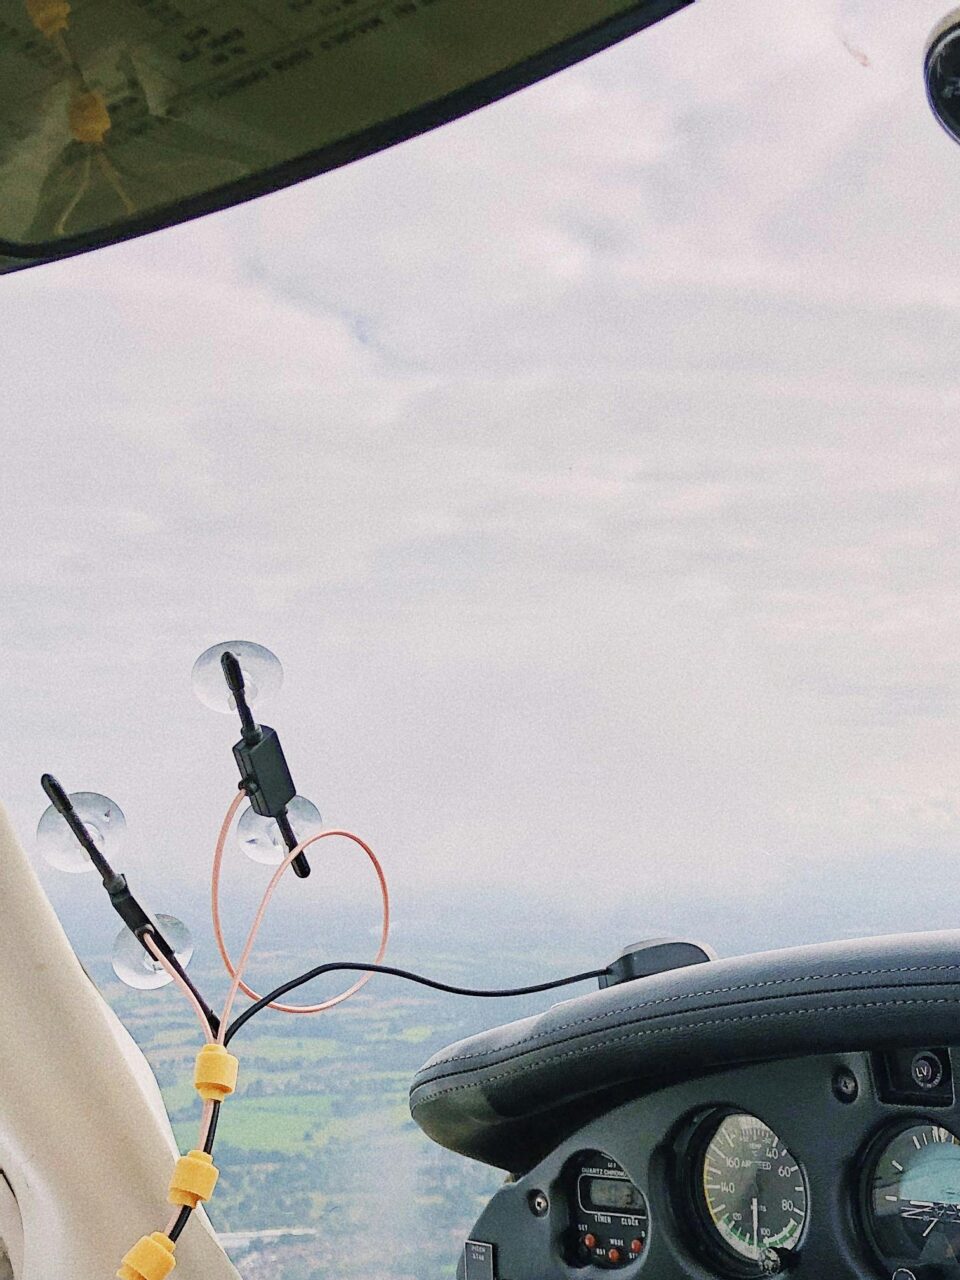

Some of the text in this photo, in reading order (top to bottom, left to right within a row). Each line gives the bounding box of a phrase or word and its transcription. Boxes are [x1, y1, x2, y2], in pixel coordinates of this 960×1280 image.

[766, 1148, 778, 1159] 40
[726, 1157, 740, 1168] 160
[778, 1166, 791, 1178] 60
[721, 1182, 734, 1193] 140
[782, 1200, 794, 1211] 80
[760, 1227, 771, 1237] 100
